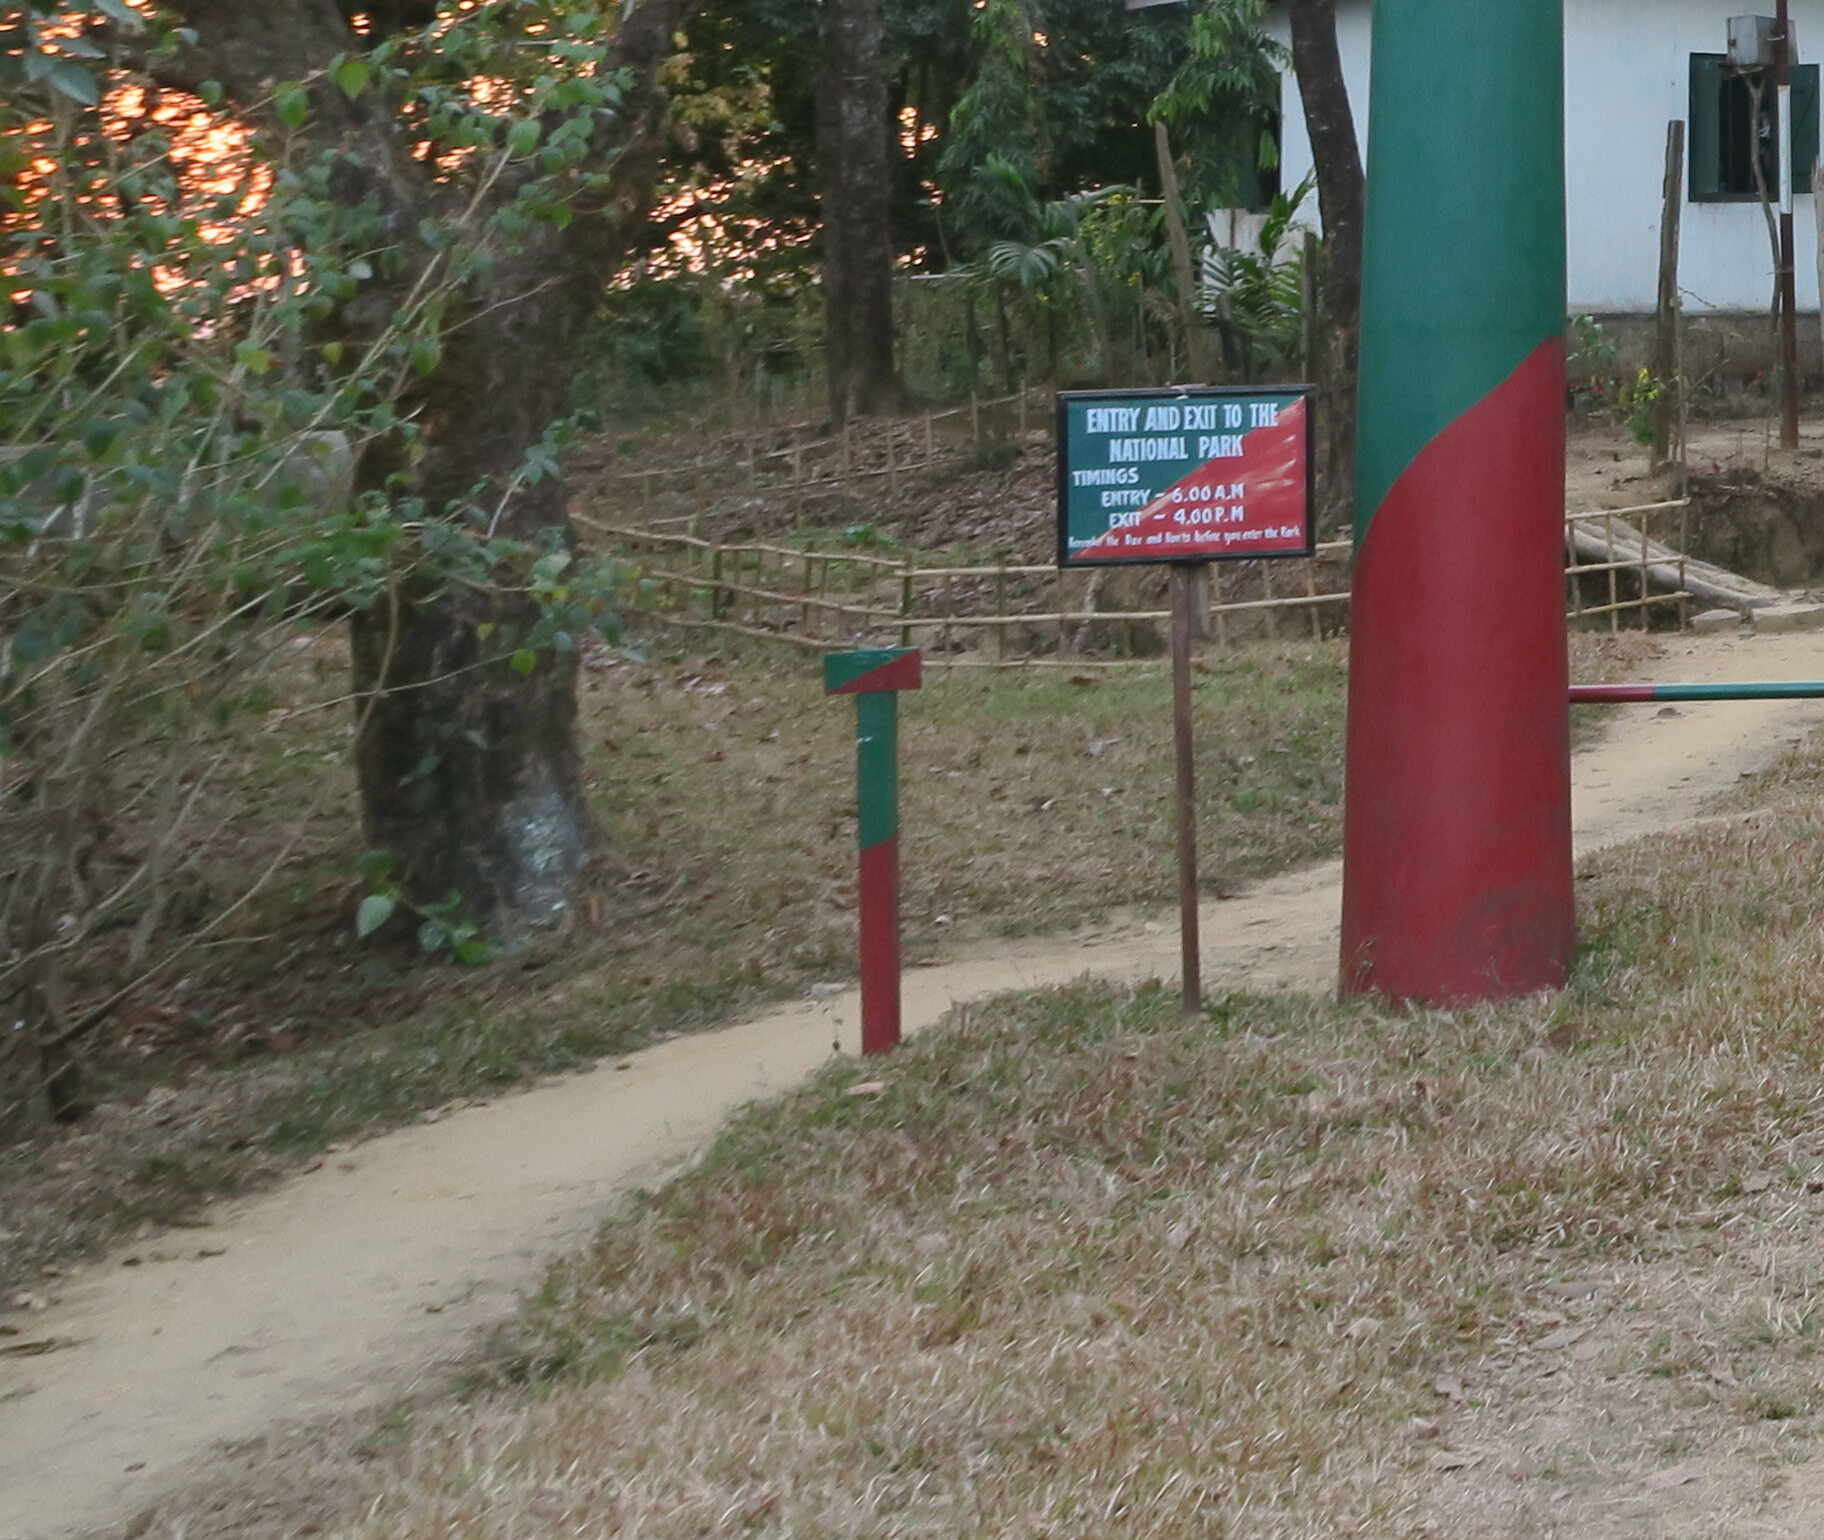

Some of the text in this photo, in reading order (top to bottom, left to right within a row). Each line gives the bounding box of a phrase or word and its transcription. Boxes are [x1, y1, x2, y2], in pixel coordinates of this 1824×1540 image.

[1086, 403, 1279, 433] ENTRY AND EXIT TO THE
[1109, 435, 1243, 462] NATIONAL PARK
[1072, 467, 1139, 486] TIMINGS
[1102, 489, 1151, 507] ENTRY
[1109, 512, 1142, 528] EXIT
